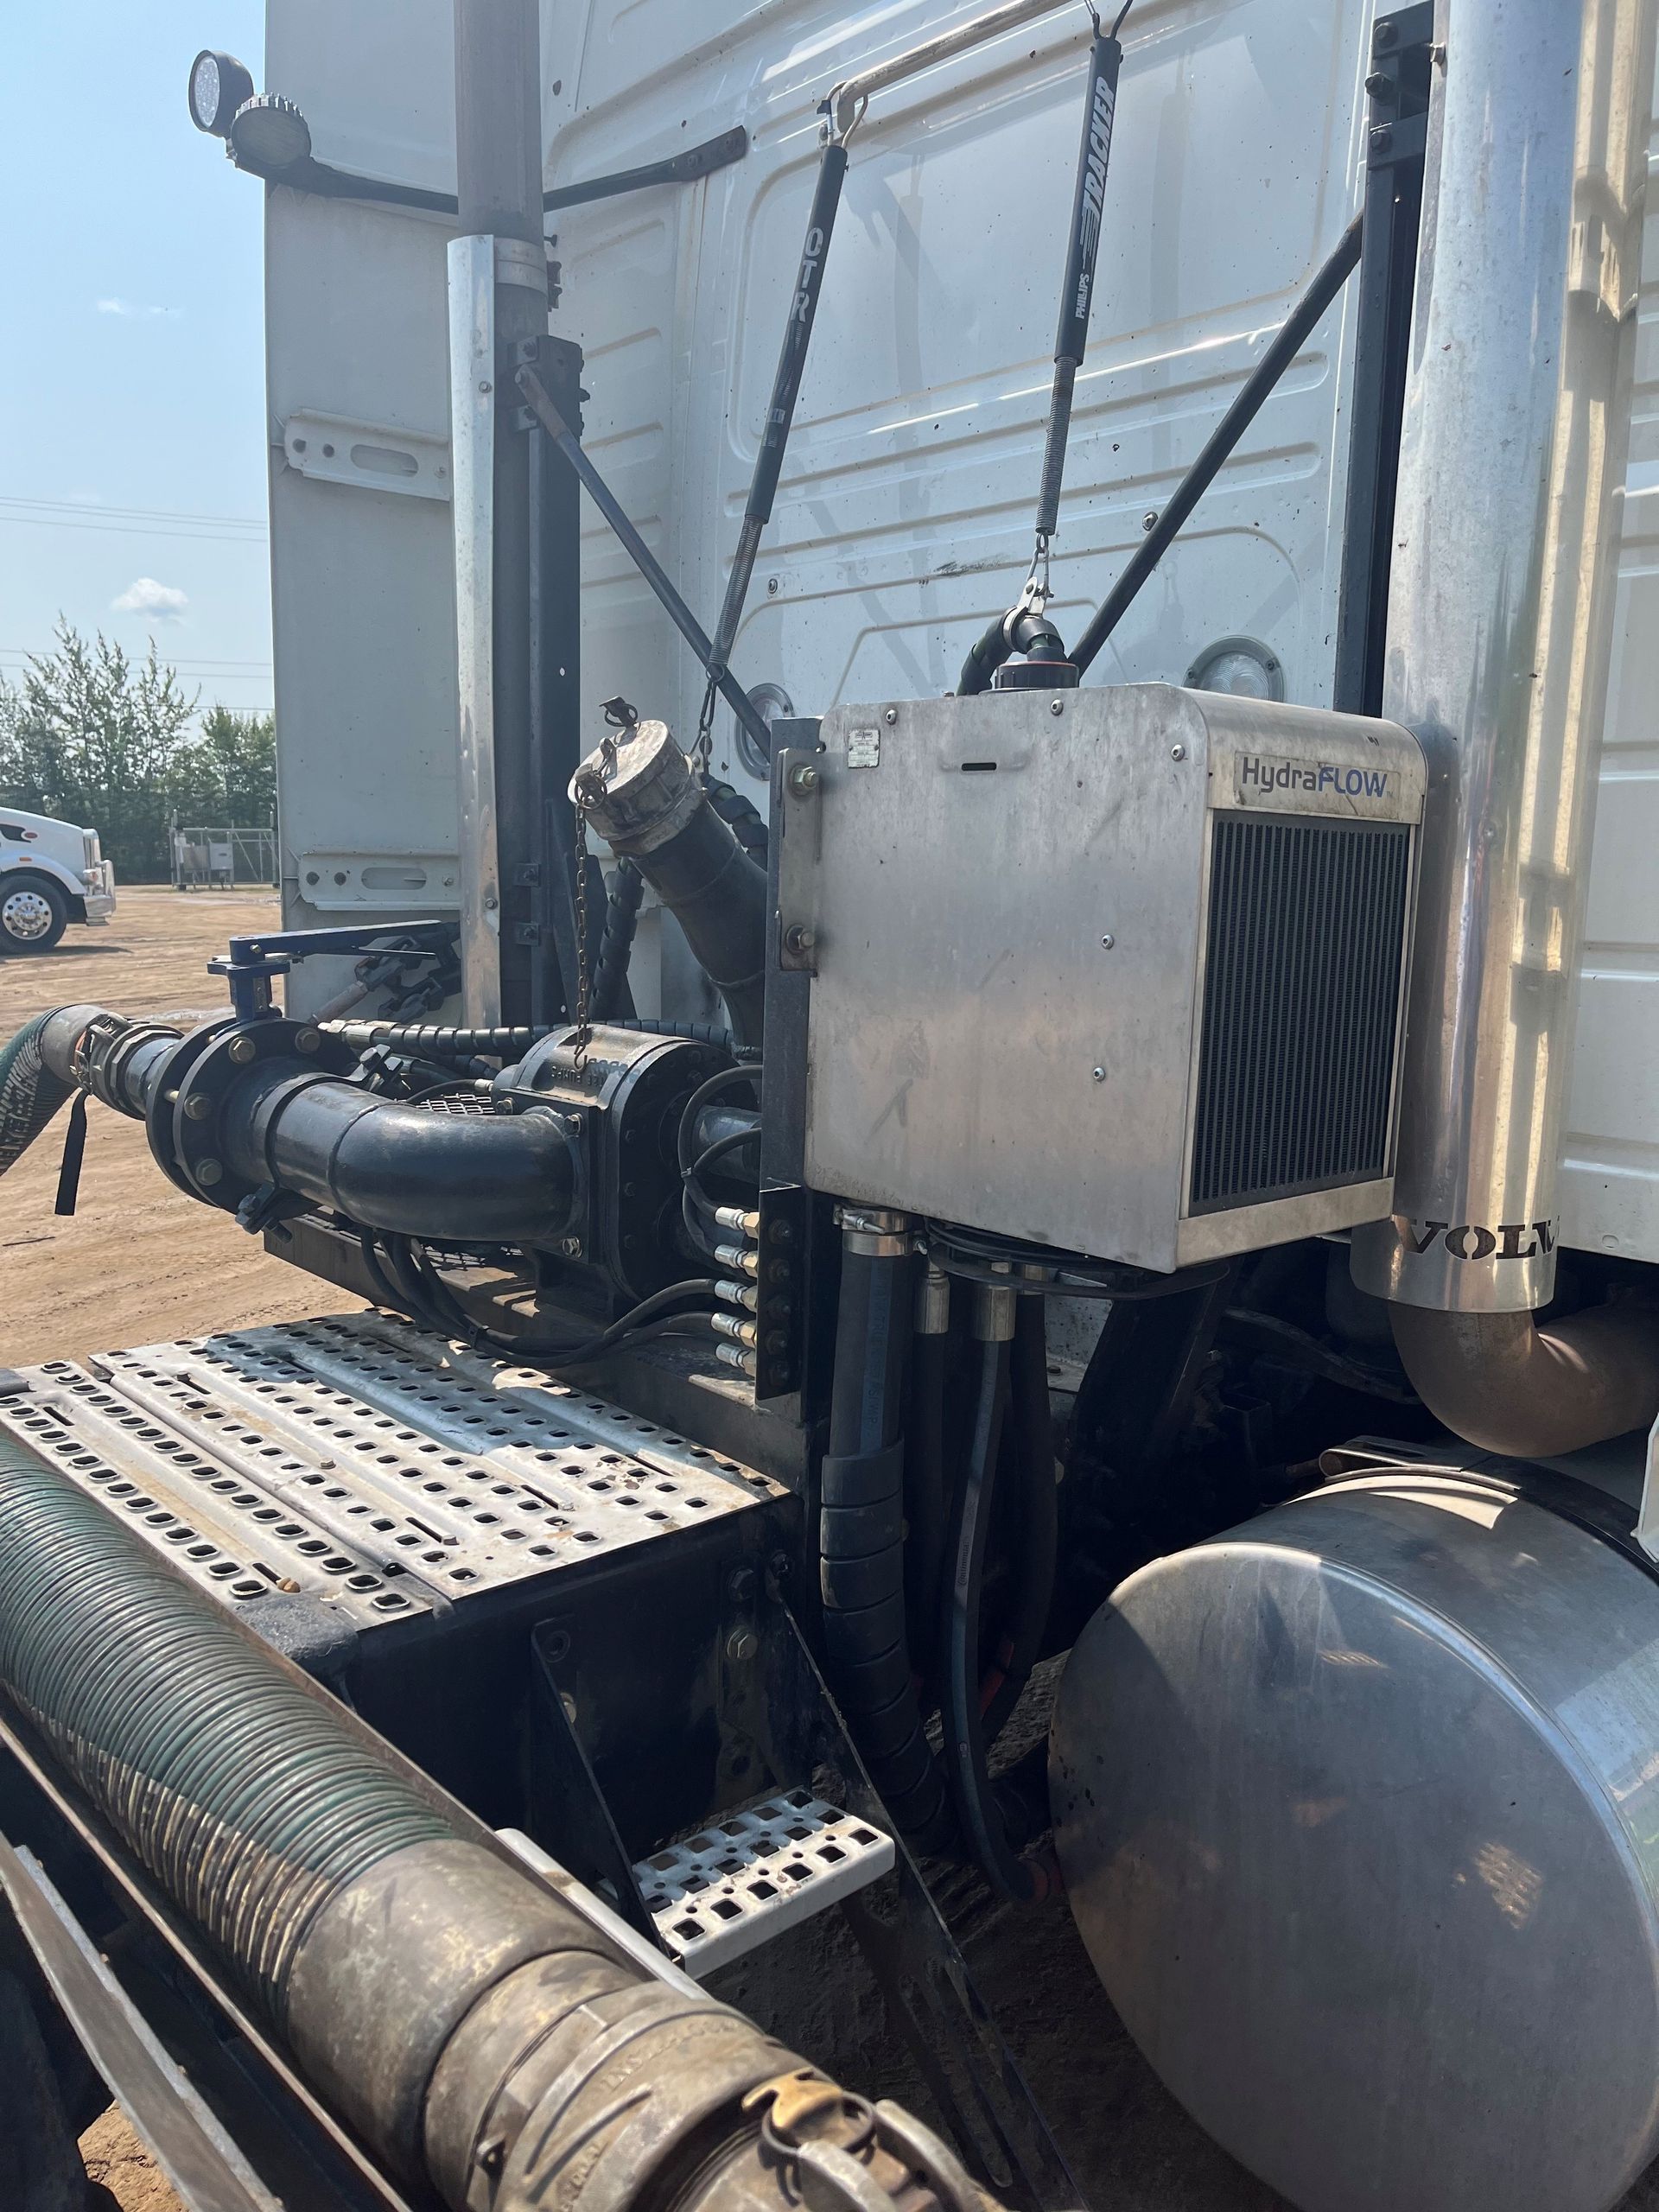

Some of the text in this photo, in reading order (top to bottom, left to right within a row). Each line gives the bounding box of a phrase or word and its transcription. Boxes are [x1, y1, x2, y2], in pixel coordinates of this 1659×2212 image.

[1081, 76, 1115, 221] TRACKER
[790, 227, 824, 322] OTR
[1242, 756, 1388, 798] HydraFLOW
[1391, 1213, 1560, 1260] VOLV
